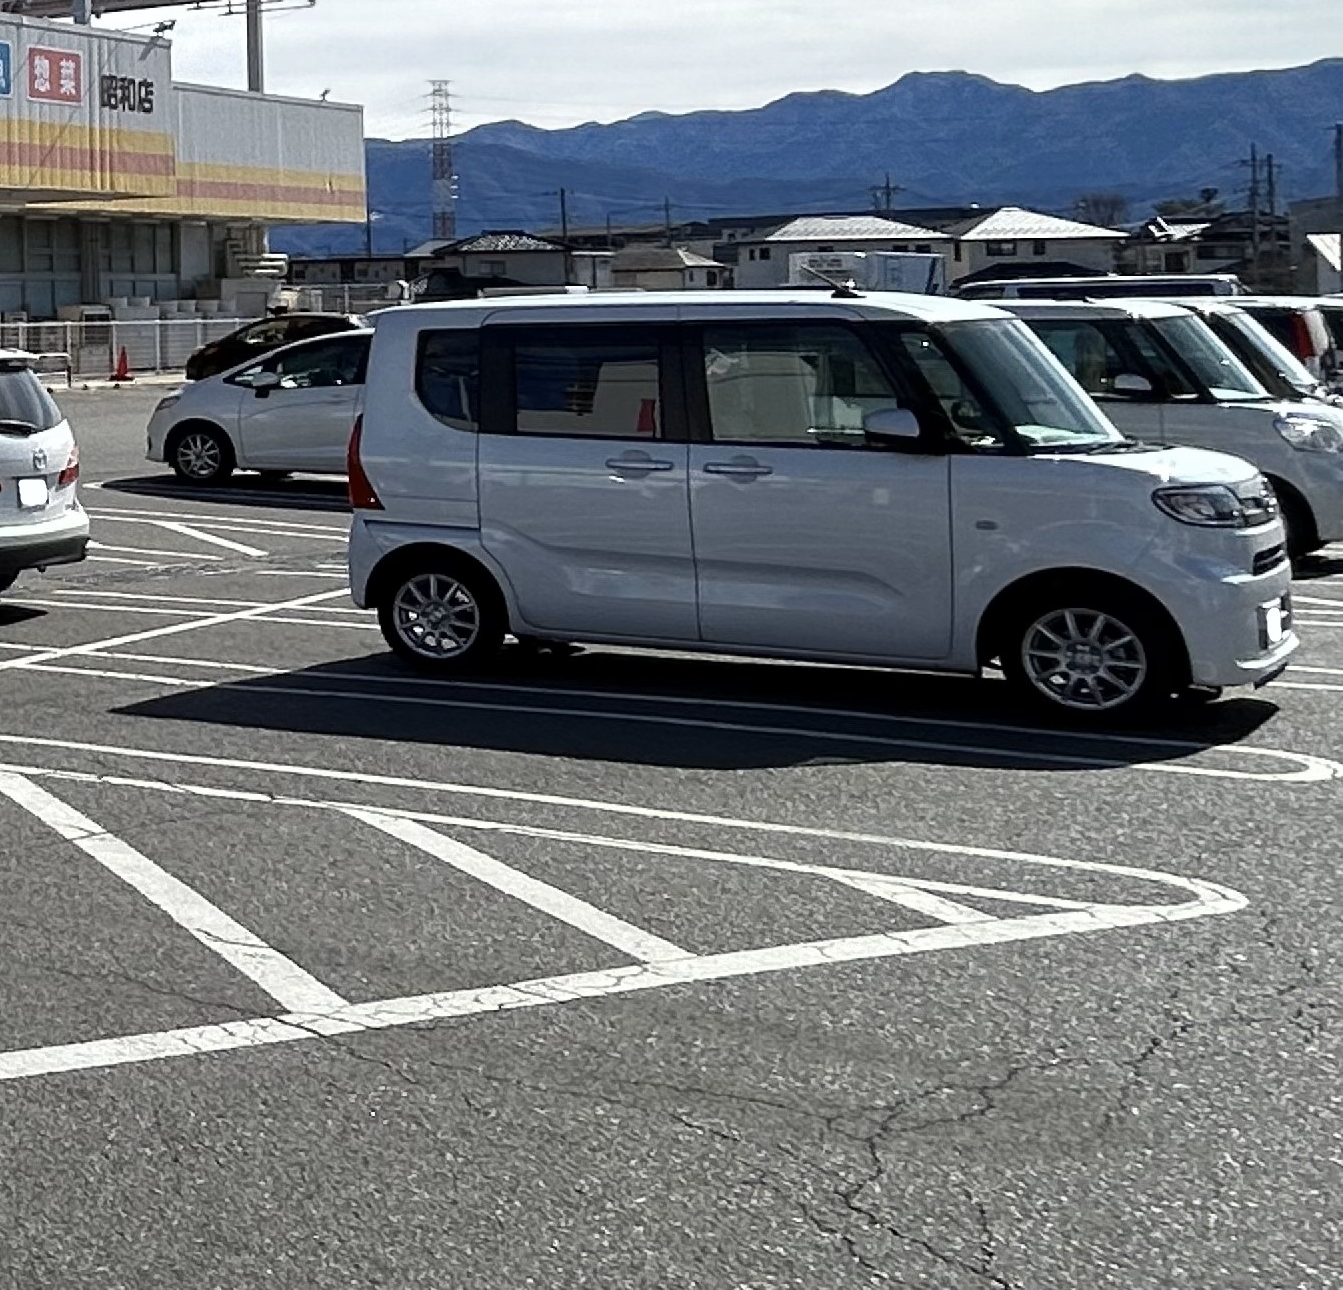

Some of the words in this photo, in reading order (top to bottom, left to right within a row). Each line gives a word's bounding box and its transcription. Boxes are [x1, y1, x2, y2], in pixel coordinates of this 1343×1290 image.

[34, 55, 76, 96] 惣菜
[101, 73, 154, 113] 昭和店
